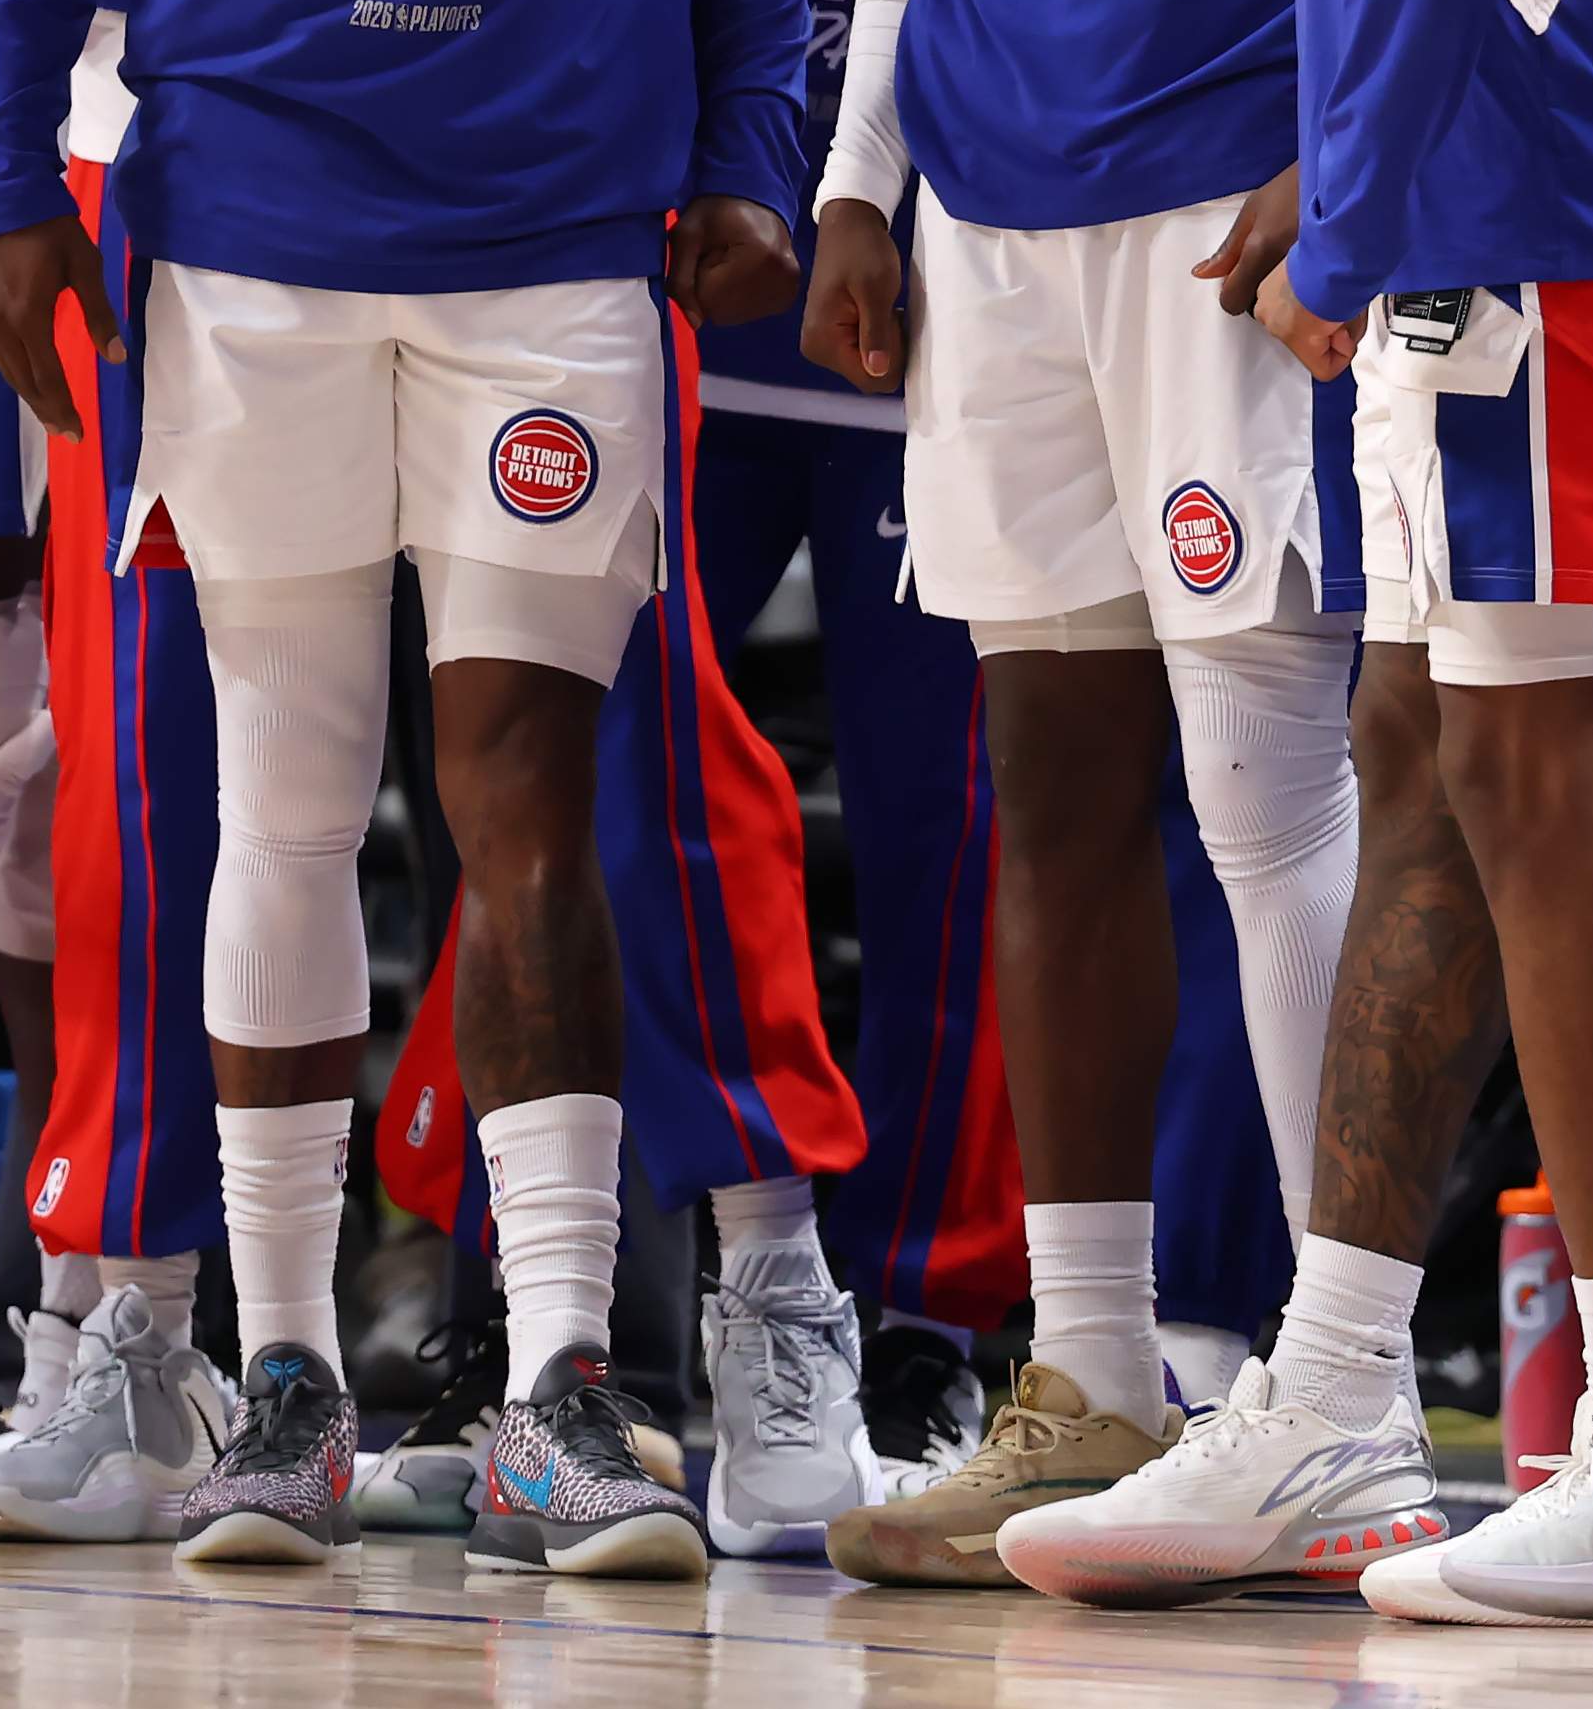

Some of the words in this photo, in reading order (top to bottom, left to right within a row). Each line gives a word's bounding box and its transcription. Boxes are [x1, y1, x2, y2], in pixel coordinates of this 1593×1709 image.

[349, 0, 394, 29] 2026
[409, 4, 482, 32] PLAYOFFS
[511, 442, 578, 471] DETROIT
[507, 460, 576, 489] PISTONS
[1173, 516, 1218, 540] DETROIT
[1176, 535, 1224, 559] PISTONS
